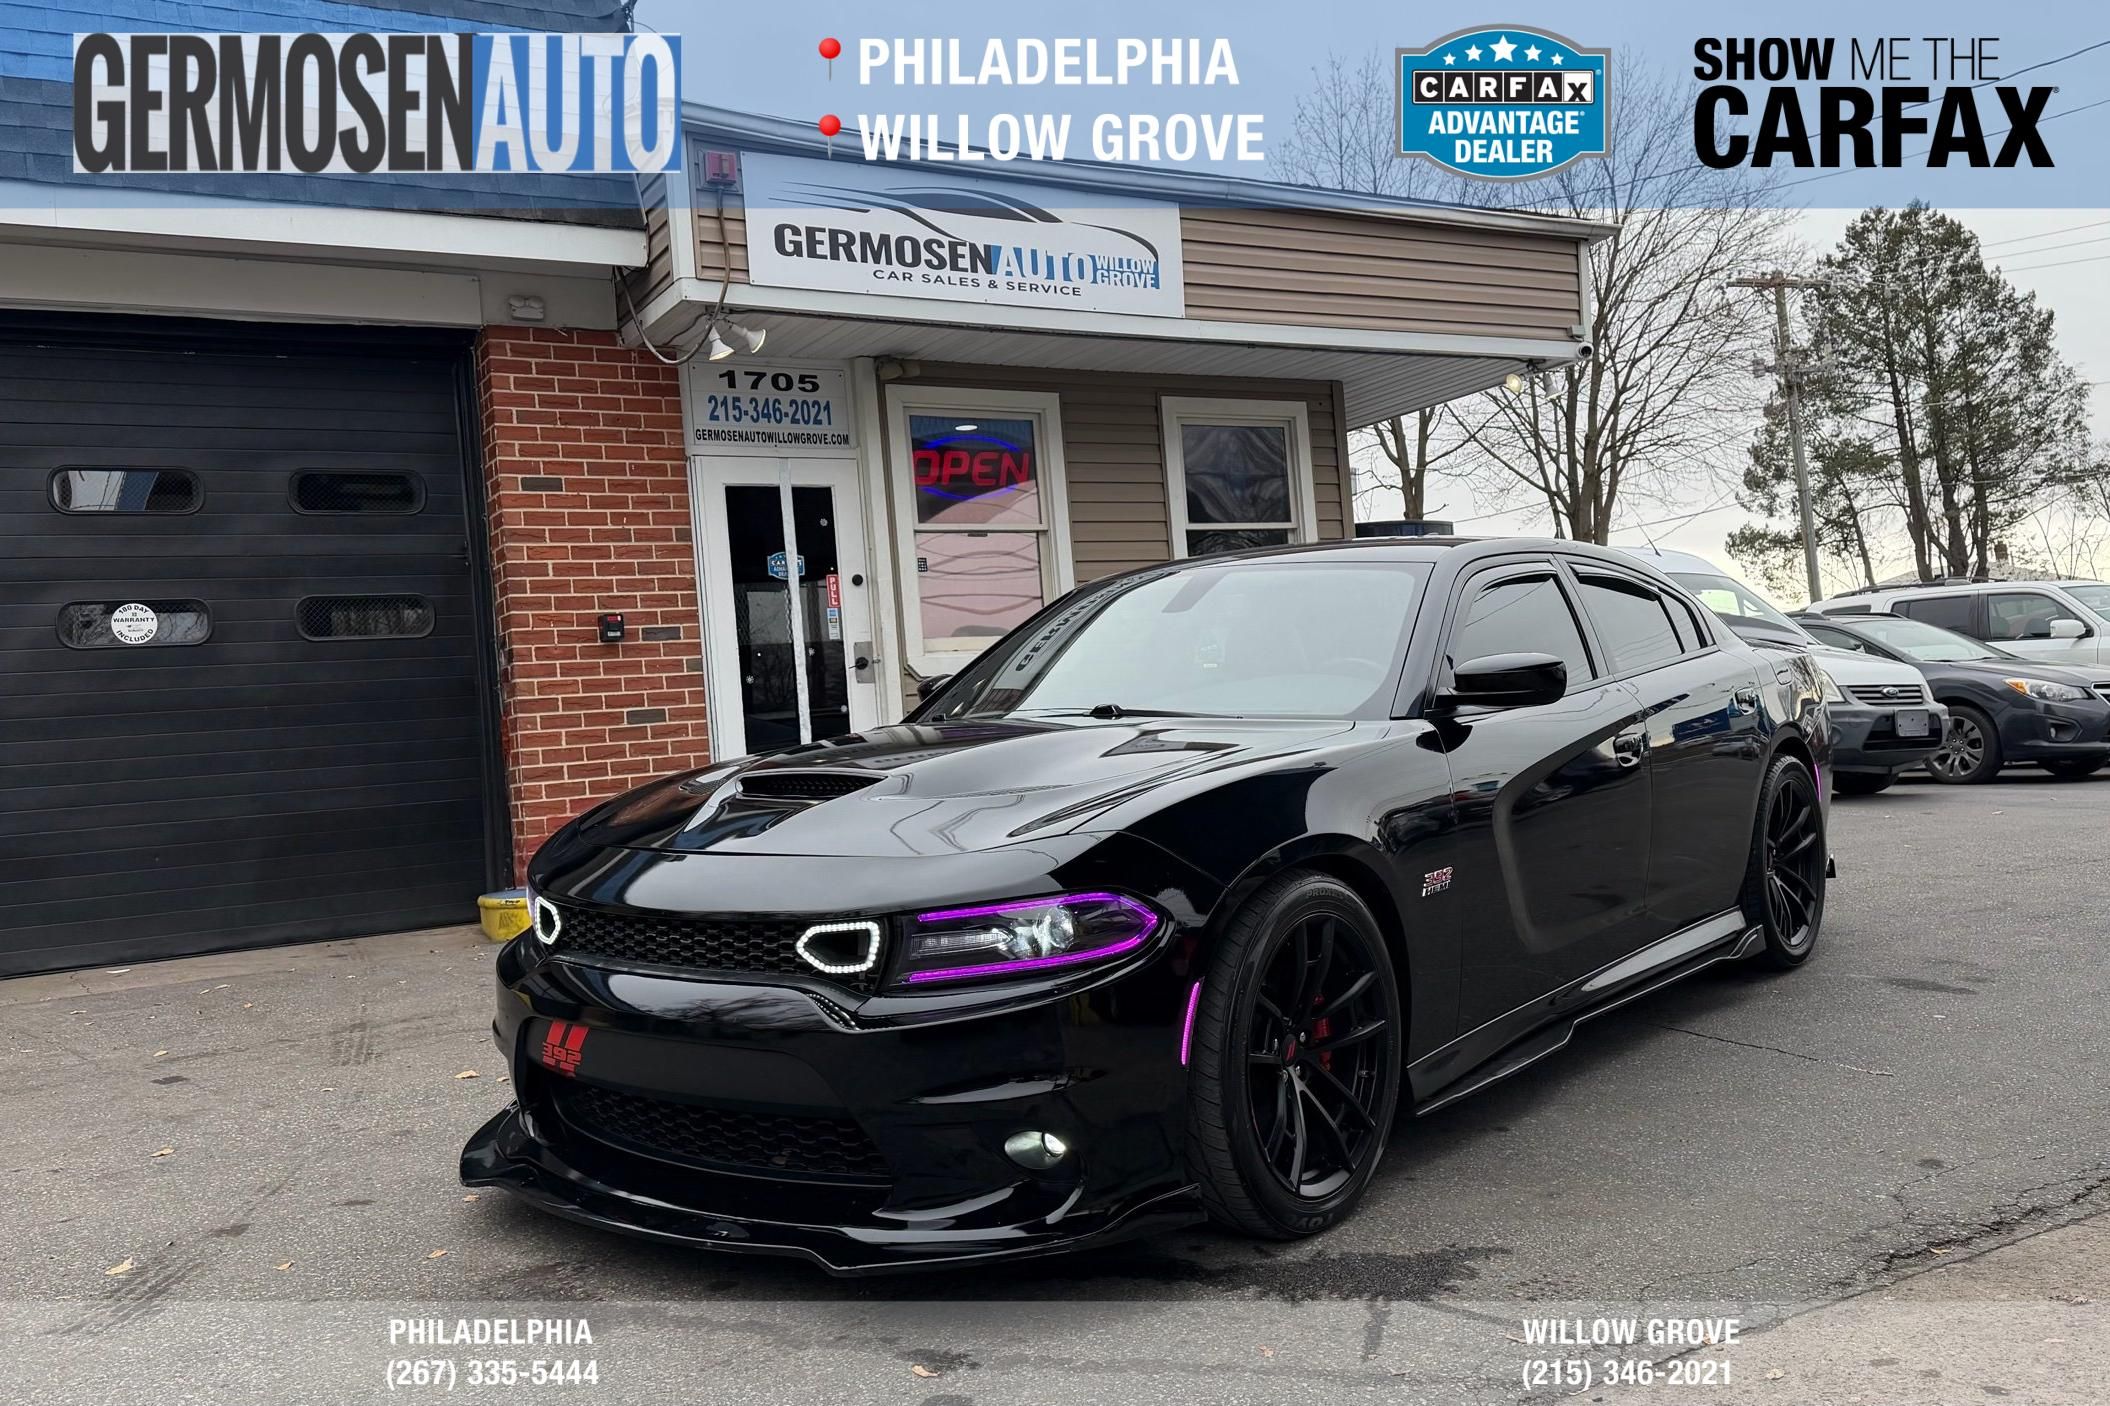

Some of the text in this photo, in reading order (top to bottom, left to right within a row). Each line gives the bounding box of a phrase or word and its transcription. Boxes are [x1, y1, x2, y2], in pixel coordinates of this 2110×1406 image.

[1095, 255, 1155, 275] WILLOW
[872, 269, 1082, 297] CAR SALES & SERVICE
[1096, 269, 1156, 291] GROVE
[718, 369, 821, 393] 1705
[707, 394, 832, 426] 215-346-2021
[695, 428, 850, 446] GERMOSENAUTOWILLOWGROVE.COM
[912, 449, 1031, 487] OPEN
[829, 577, 838, 605] PULL
[134, 605, 150, 613] DAY
[117, 629, 153, 641] INCLUDED
[1424, 866, 1453, 887] 392
[541, 1041, 582, 1065] 392
